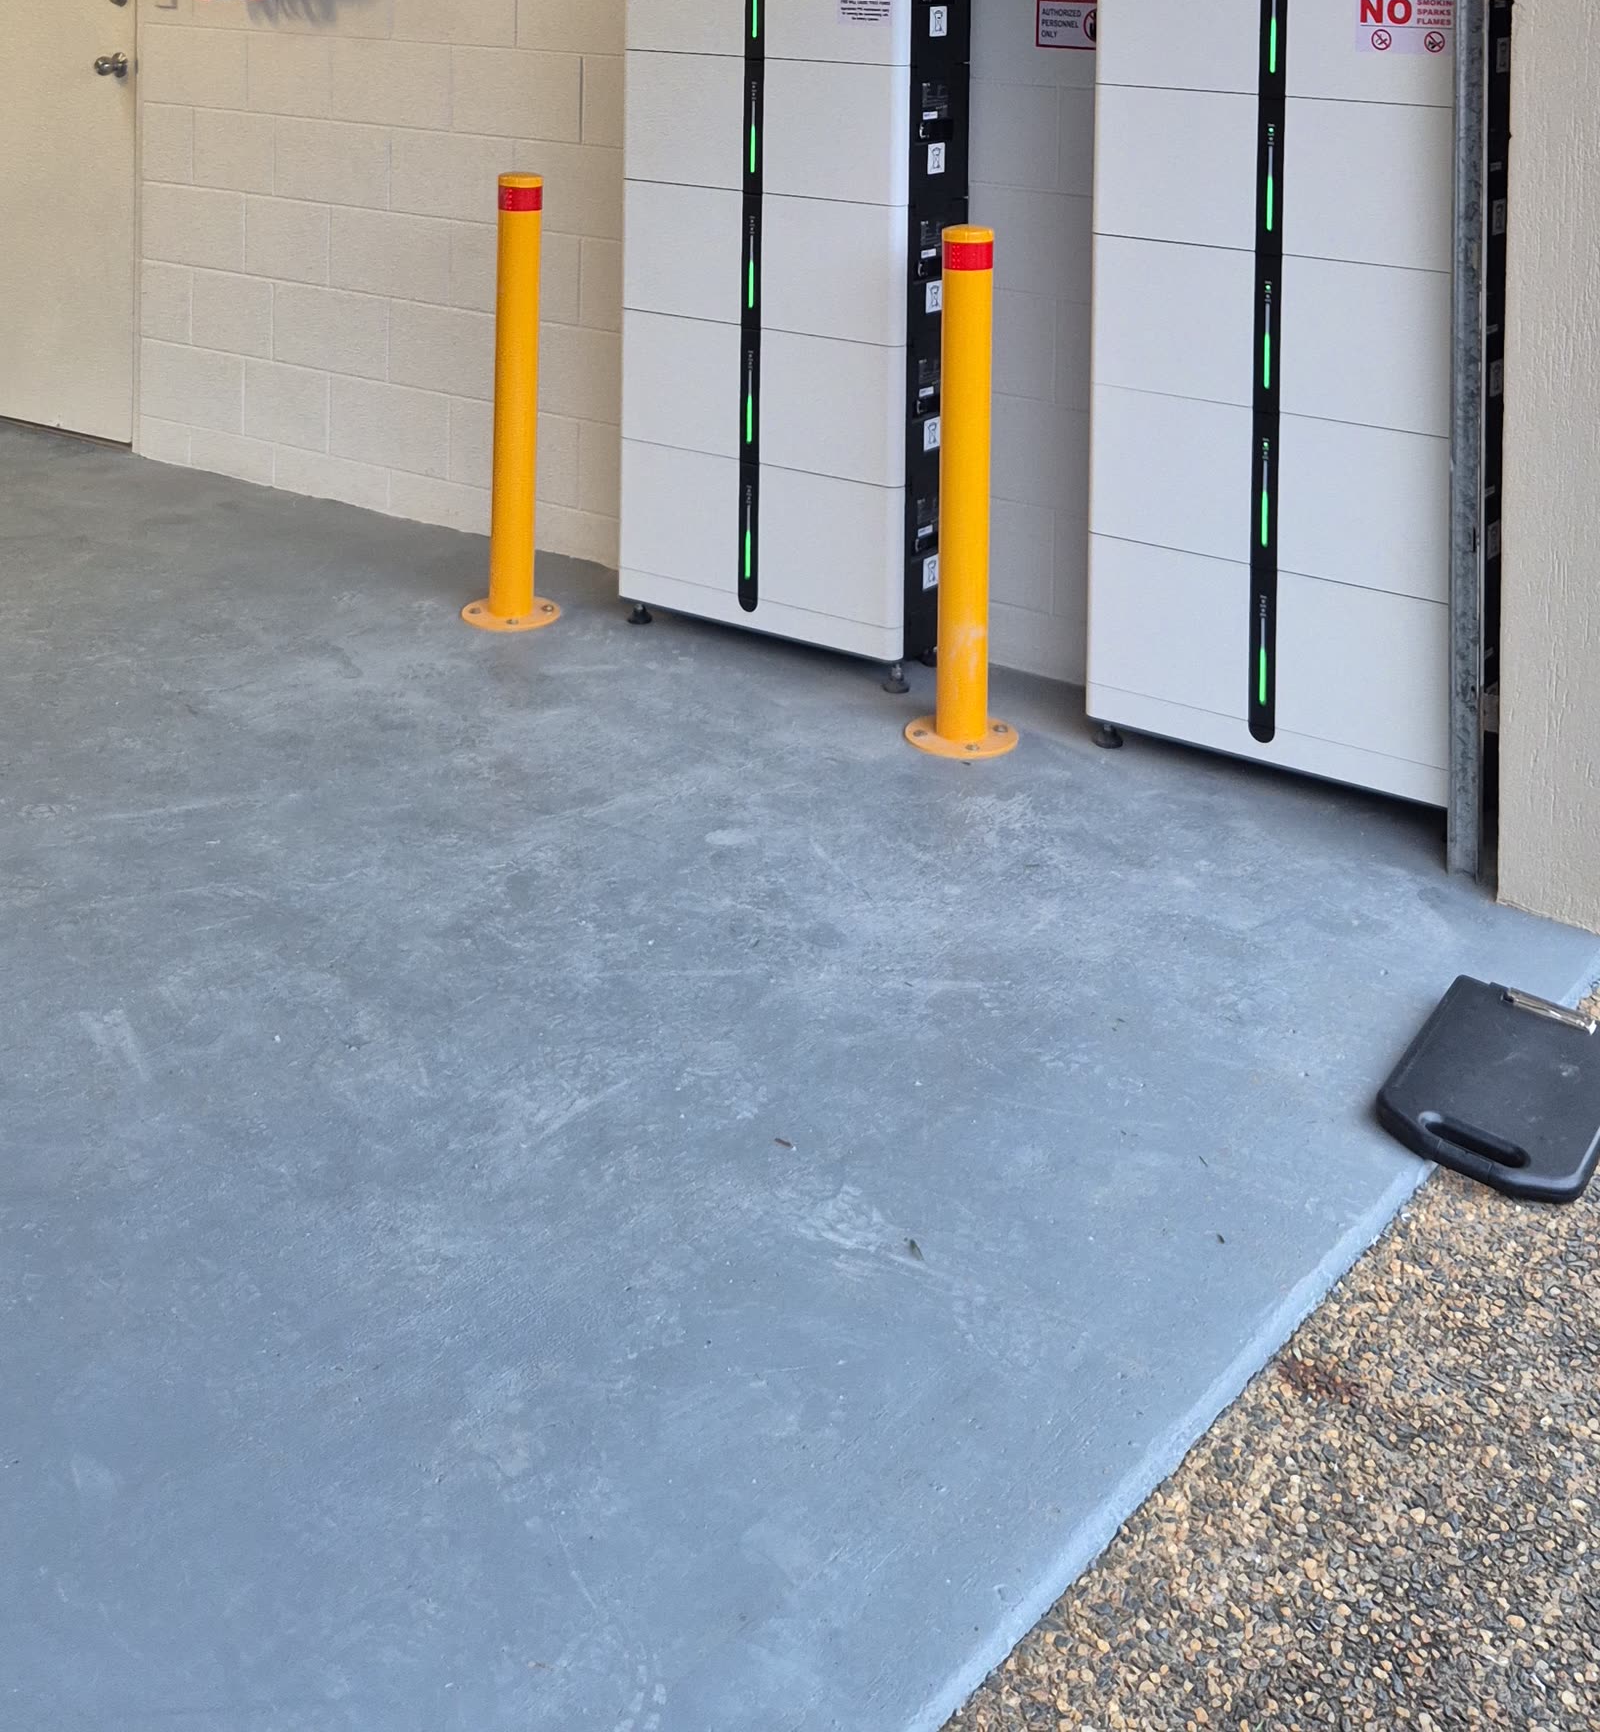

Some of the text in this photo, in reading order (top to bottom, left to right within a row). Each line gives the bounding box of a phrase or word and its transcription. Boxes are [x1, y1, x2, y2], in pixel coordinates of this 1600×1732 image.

[1042, 8, 1081, 17] AUTHORIZED
[1416, 8, 1452, 16] SPARKS
[1041, 19, 1079, 28] PERSONNEL
[1416, 18, 1452, 26] FLAMES
[1041, 29, 1057, 38] ONLY
